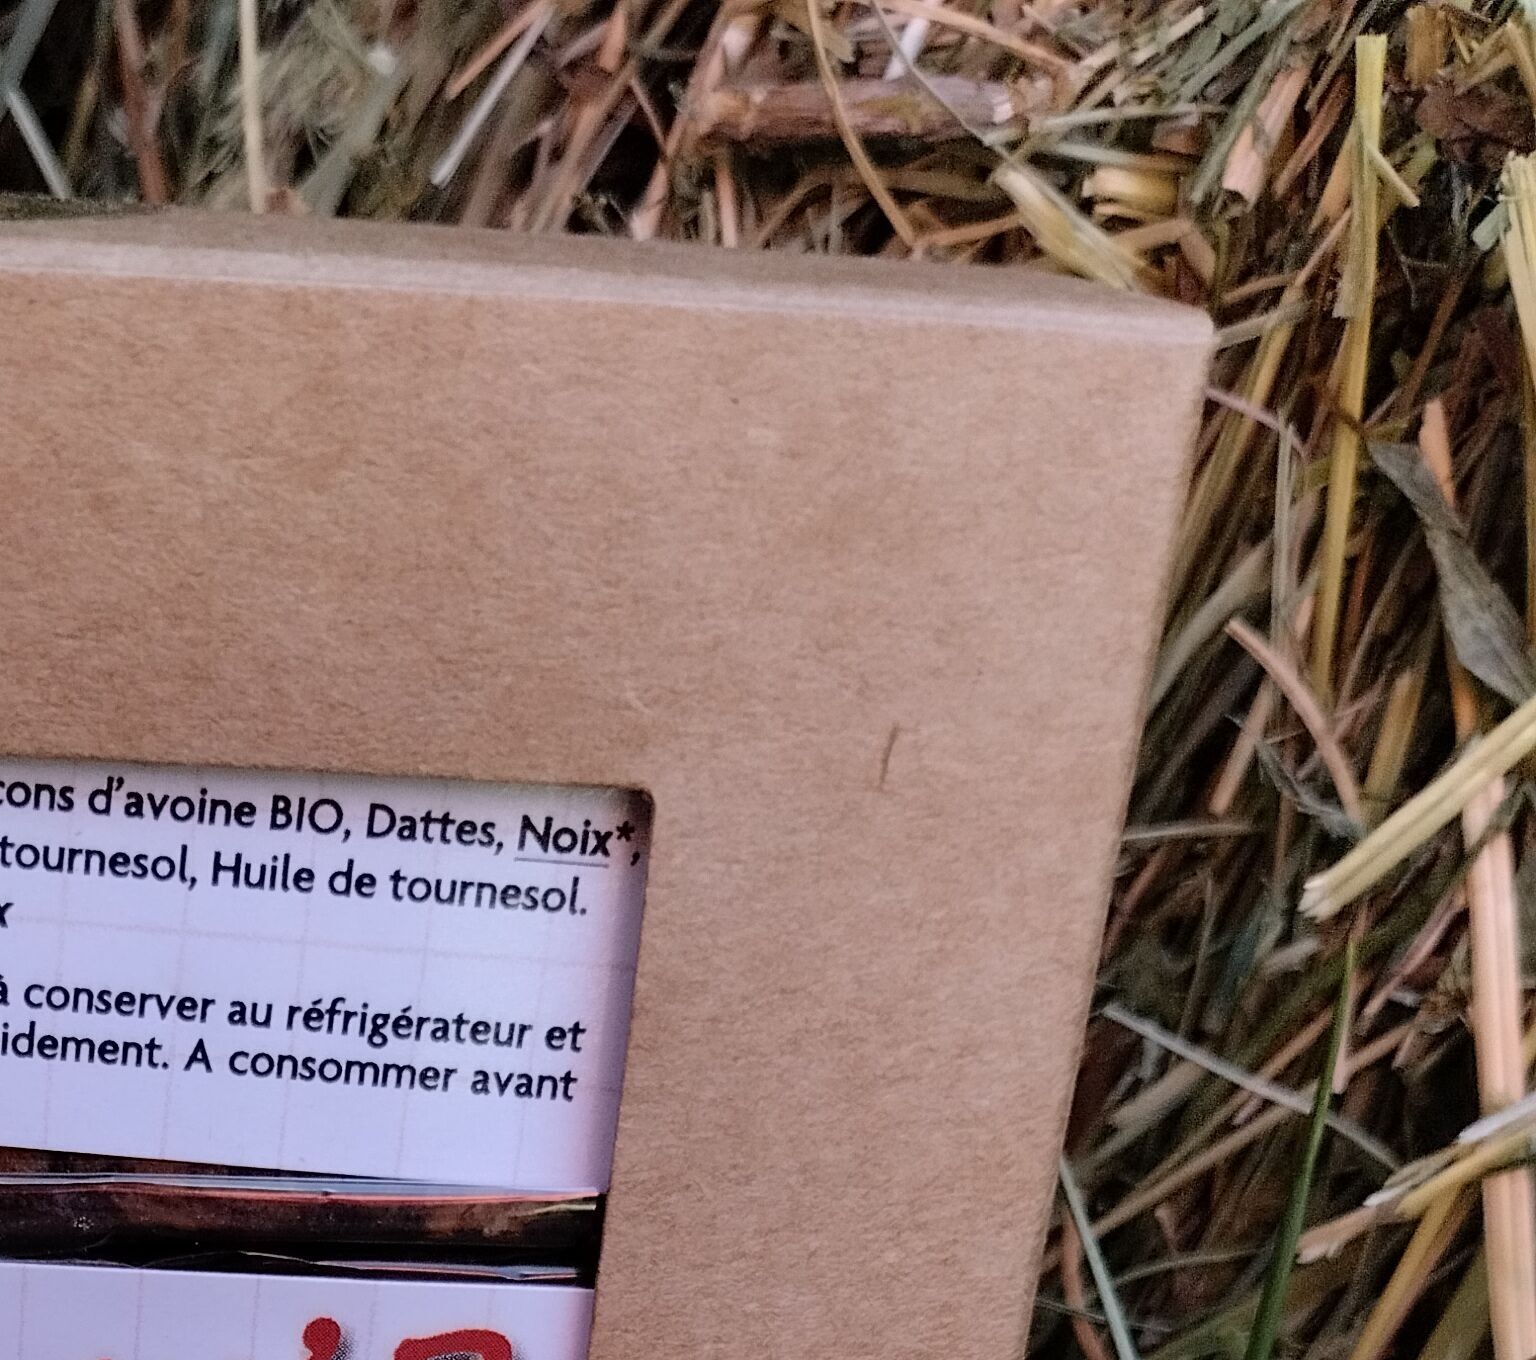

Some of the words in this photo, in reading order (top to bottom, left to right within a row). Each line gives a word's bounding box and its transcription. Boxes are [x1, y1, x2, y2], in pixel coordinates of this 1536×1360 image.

[269, 794, 352, 844] BIO,
[366, 802, 505, 855] Dattes,
[211, 850, 315, 895] Huile
[328, 858, 377, 898] de
[390, 868, 588, 917] tournesol.
[23, 980, 216, 1025] conserver
[226, 999, 273, 1030] au
[286, 996, 533, 1050] réfrigérateur
[545, 1018, 587, 1054] et
[183, 1037, 213, 1074] A
[227, 1047, 457, 1093] consommer
[470, 1066, 578, 1103] avant
